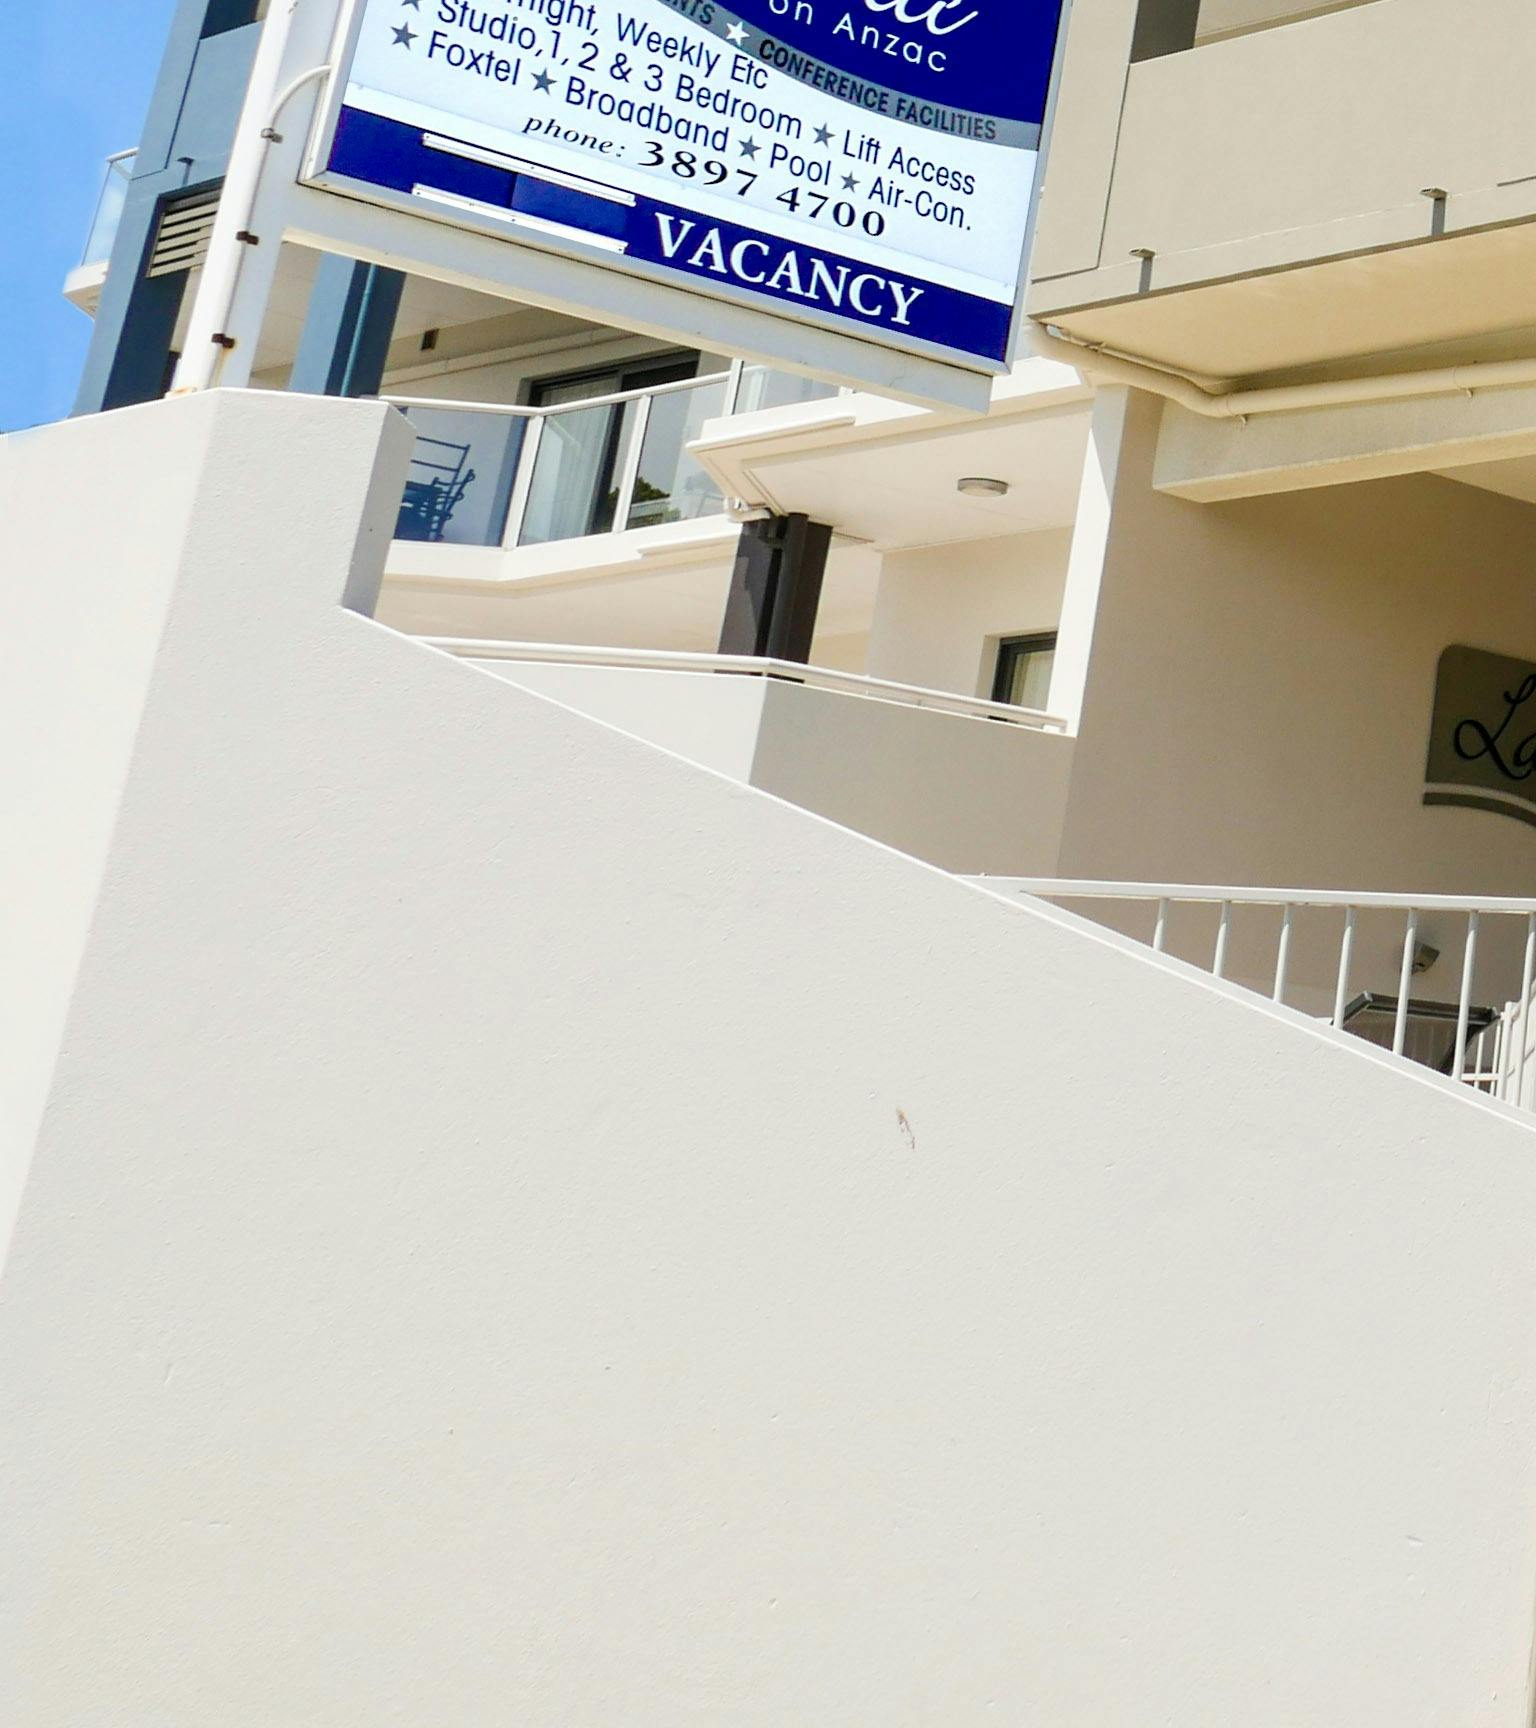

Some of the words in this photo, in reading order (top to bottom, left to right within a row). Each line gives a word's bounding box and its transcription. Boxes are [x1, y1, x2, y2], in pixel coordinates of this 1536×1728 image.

[617, 13, 720, 78] Weekly
[731, 54, 768, 89] Etc
[759, 39, 889, 112] CONFERENCE
[895, 98, 997, 140] FACILITIES
[833, 13, 947, 72] Anzac
[428, 30, 521, 86] Foxtel
[565, 76, 729, 153] Broadband
[769, 143, 831, 186] Pool
[868, 176, 971, 230] Air-Con.
[578, 41, 599, 71] 2
[609, 52, 631, 83] &
[643, 64, 663, 92] 3
[675, 73, 801, 139] Bedroom
[843, 129, 881, 165] Lift
[888, 146, 975, 195] Access
[522, 117, 625, 158] phone:
[637, 141, 758, 197] 3897
[775, 186, 885, 236] 4700
[654, 212, 925, 326] VACANCY
